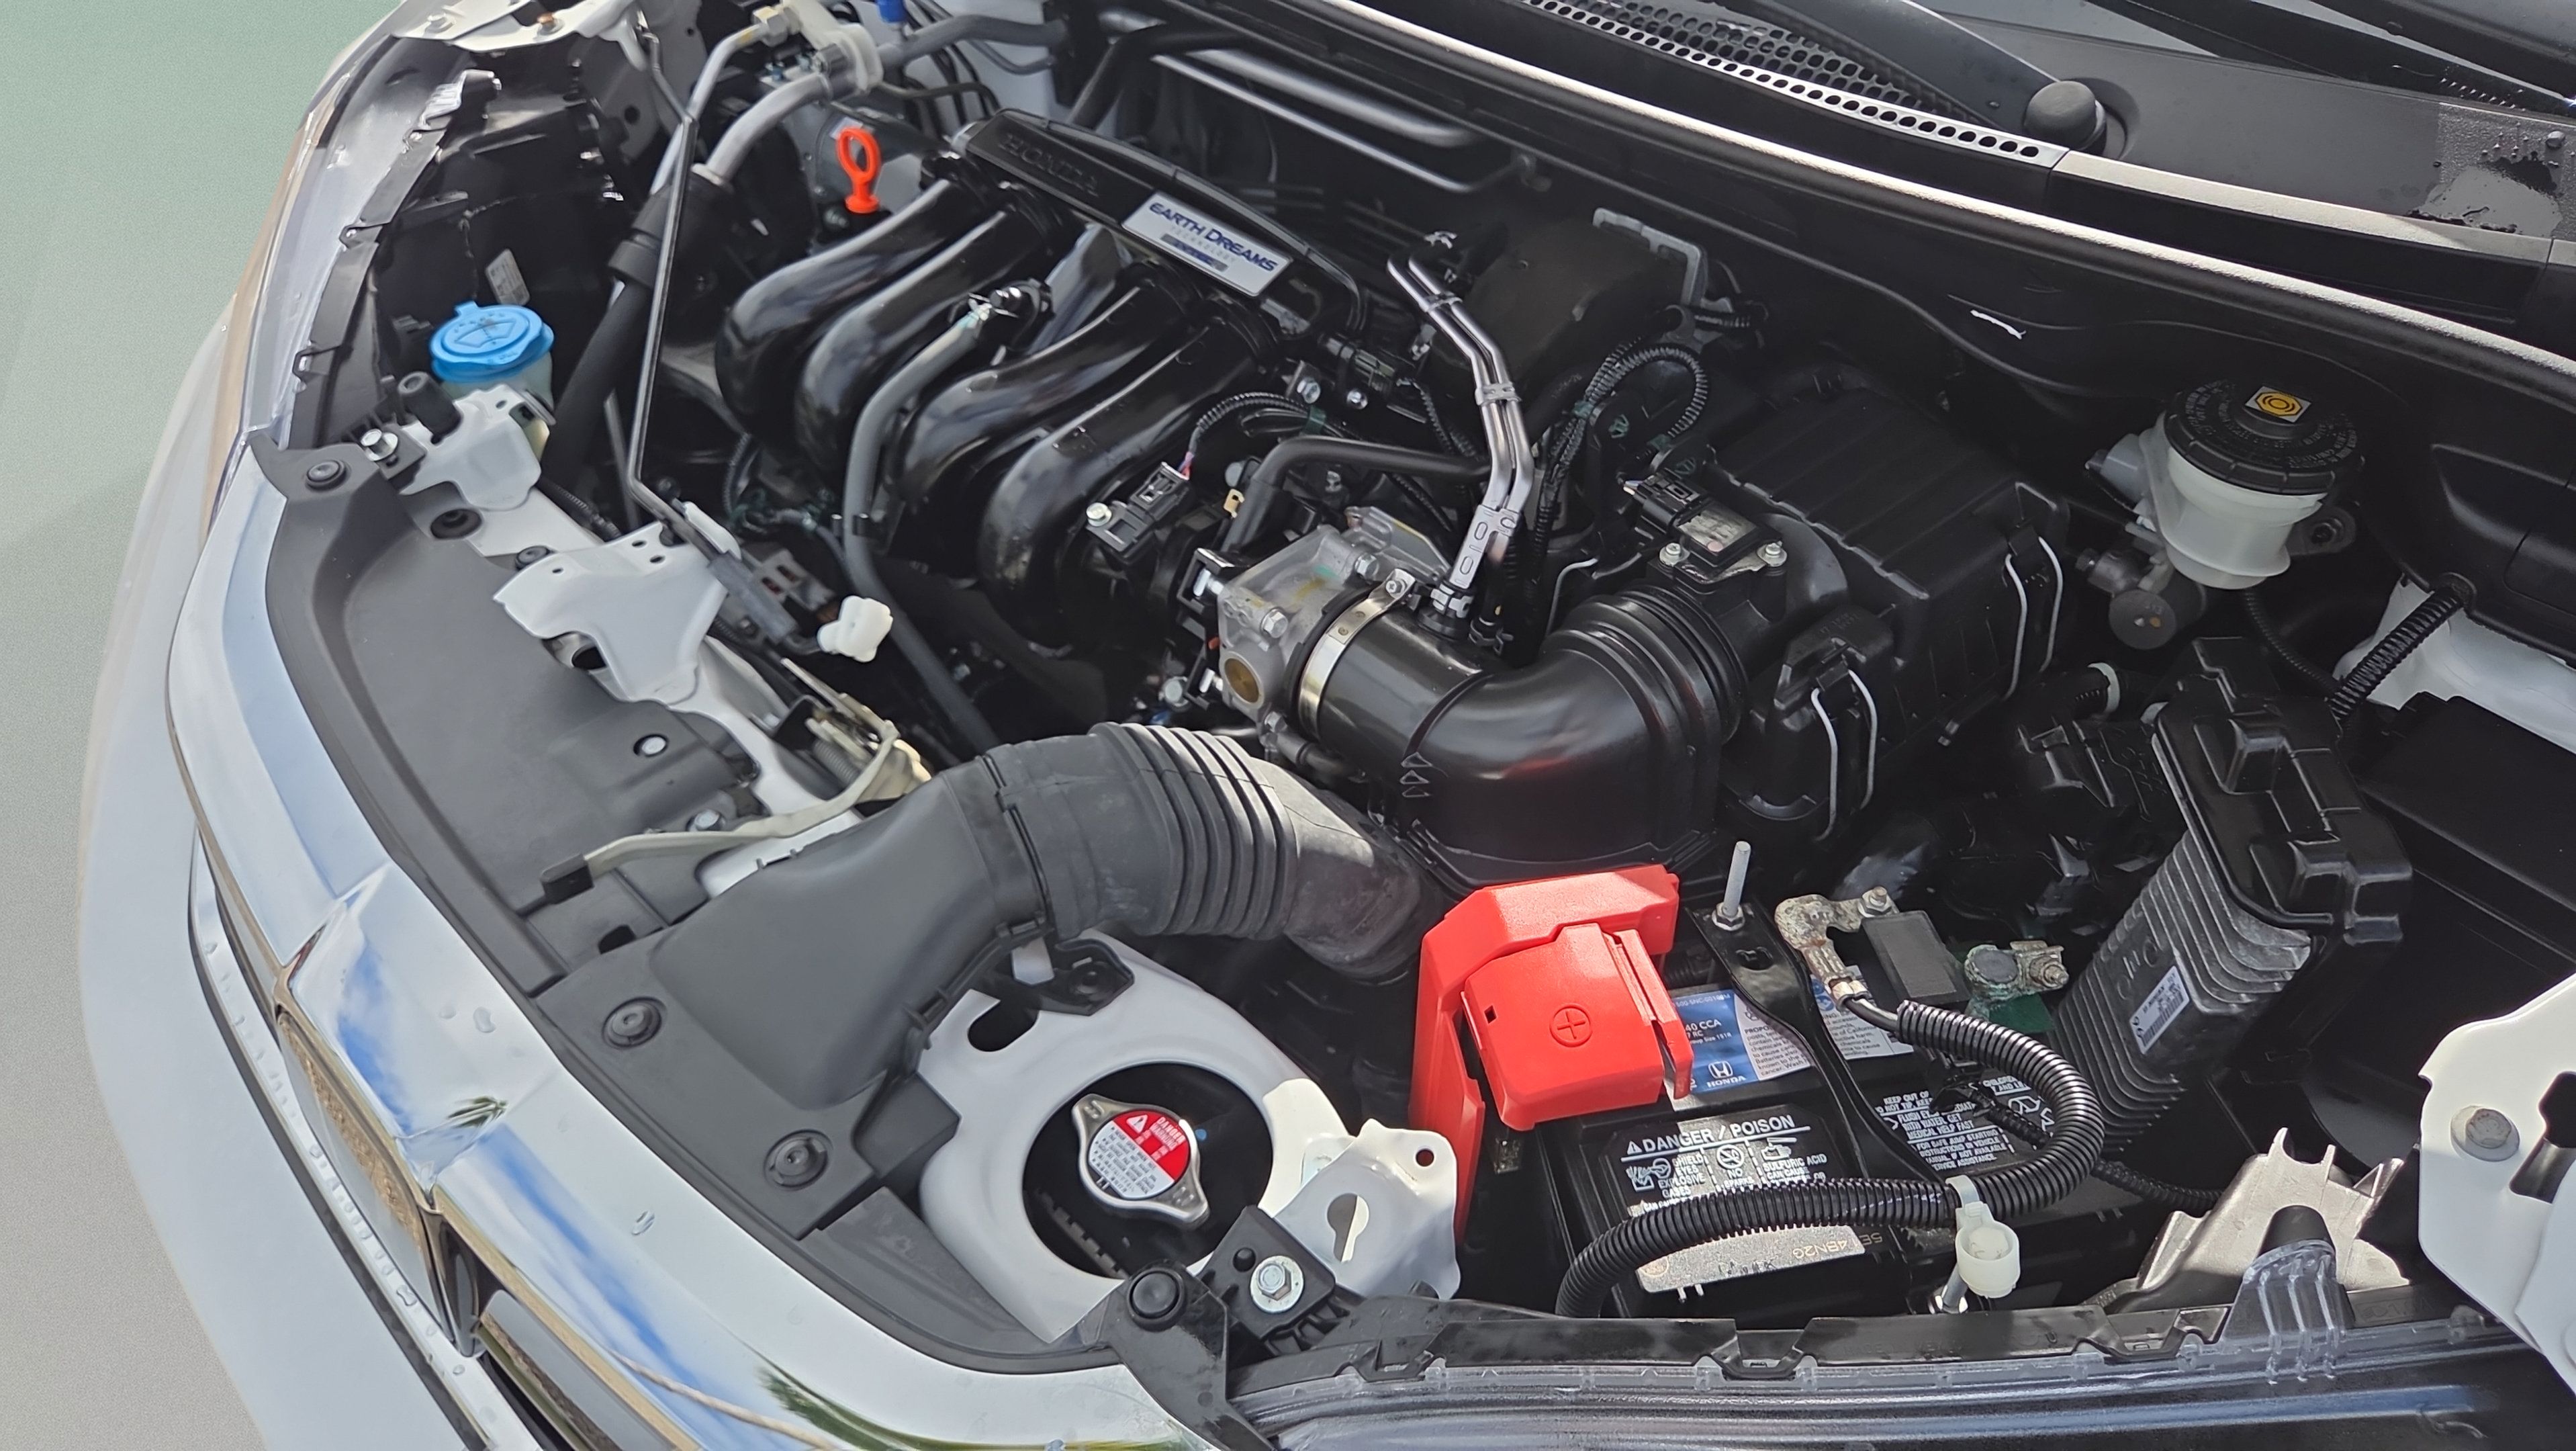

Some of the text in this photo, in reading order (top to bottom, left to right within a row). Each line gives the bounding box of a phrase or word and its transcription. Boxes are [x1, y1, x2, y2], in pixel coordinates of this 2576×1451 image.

[1149, 202, 1207, 236] EARTH
[1698, 1018, 1722, 1030] CCA
[1706, 1075, 1747, 1088] HONDA
[1883, 1095, 1902, 1106] KEEP
[1902, 1092, 1919, 1102] OUT
[1884, 1102, 1900, 1112] NOT
[1897, 1110, 1921, 1124] FLUSH
[1947, 1112, 1962, 1124] GET
[1156, 1116, 1187, 1144] DANGER
[1643, 1128, 1716, 1153] DANGER
[1730, 1114, 1796, 1137] POISON
[1906, 1119, 1975, 1140] MEDICAL HELP FAST
[1671, 1152, 1704, 1167] SHIELD
[1762, 1153, 1828, 1172] SULFURIC ACID
[1675, 1163, 1700, 1176] EYES
[1727, 1168, 1743, 1180] NO
[1767, 1170, 1784, 1180] CAN
[1784, 1166, 1810, 1178] CAUSE
[1657, 1172, 1706, 1190] EXPLOSIVE
[1662, 1185, 1692, 1199] GASES
